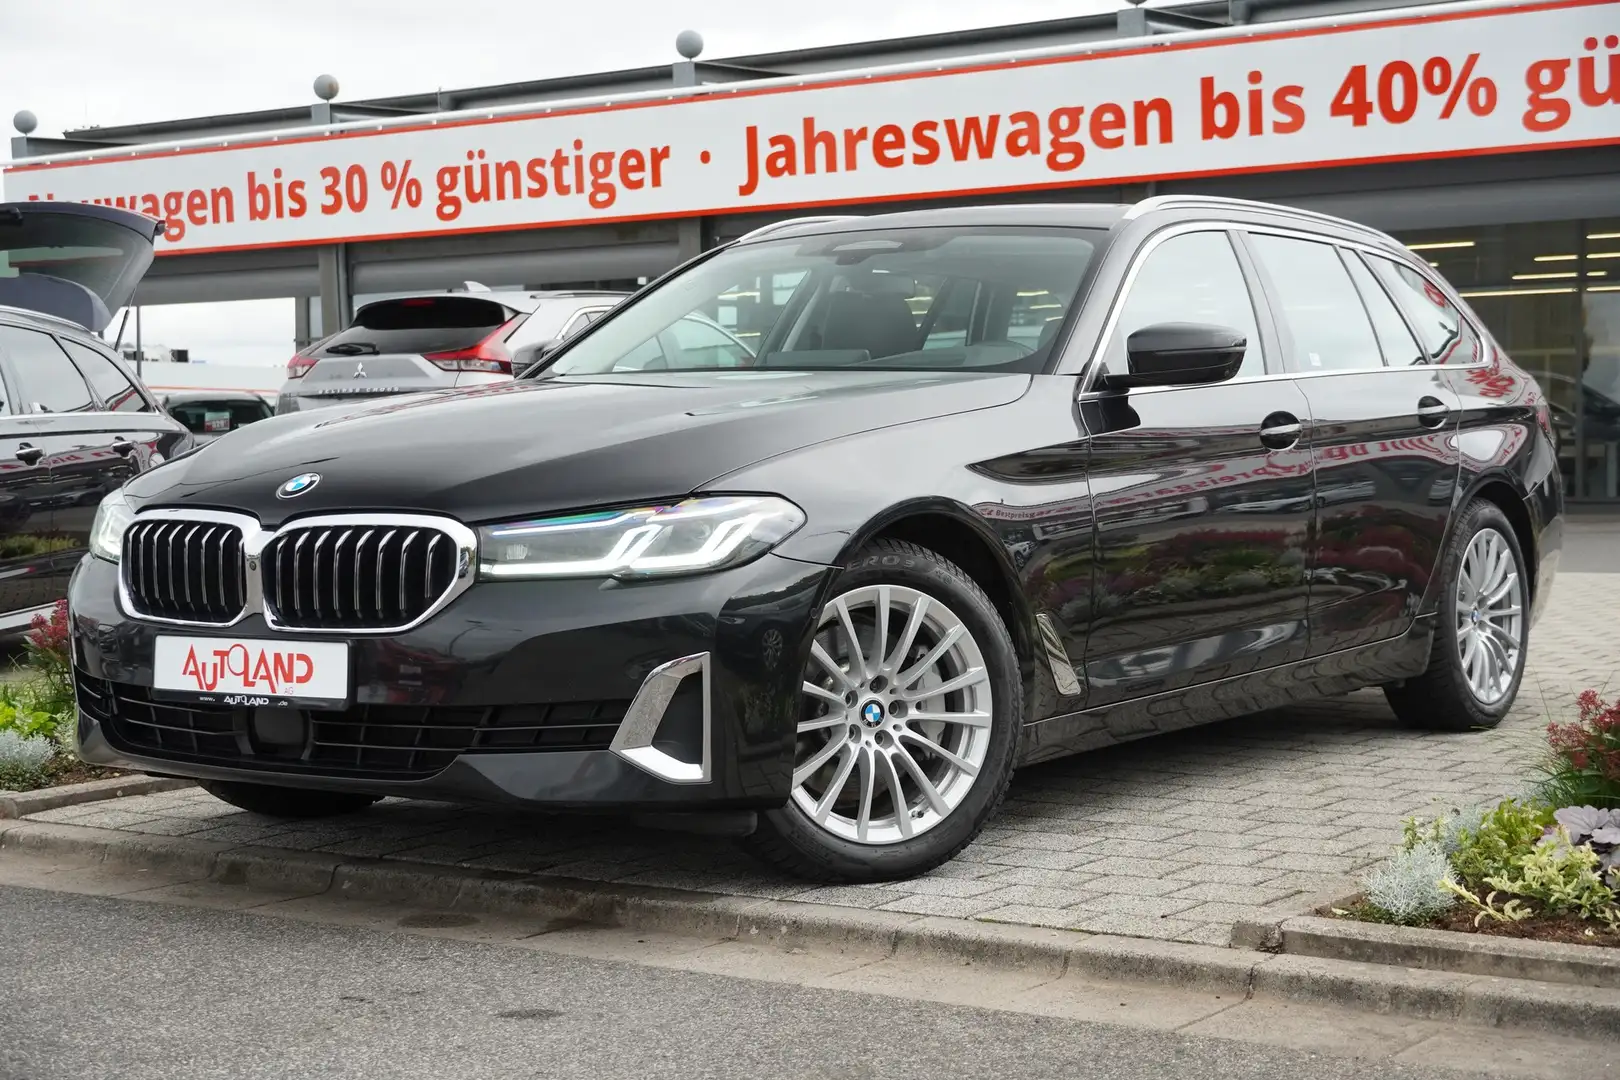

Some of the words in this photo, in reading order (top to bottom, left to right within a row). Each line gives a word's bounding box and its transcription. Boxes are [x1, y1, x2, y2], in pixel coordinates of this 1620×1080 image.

[28, 188, 235, 242] agen
[248, 167, 307, 221] bis
[321, 165, 368, 216] 30
[381, 160, 423, 210] %
[436, 140, 672, 222] günstiger
[738, 97, 1174, 197] Jahreswagen
[1200, 71, 1306, 141] bis
[1330, 53, 1498, 127] 40%
[1522, 35, 1620, 133] gü
[846, 555, 901, 572] ERO
[284, 687, 294, 695] AG
